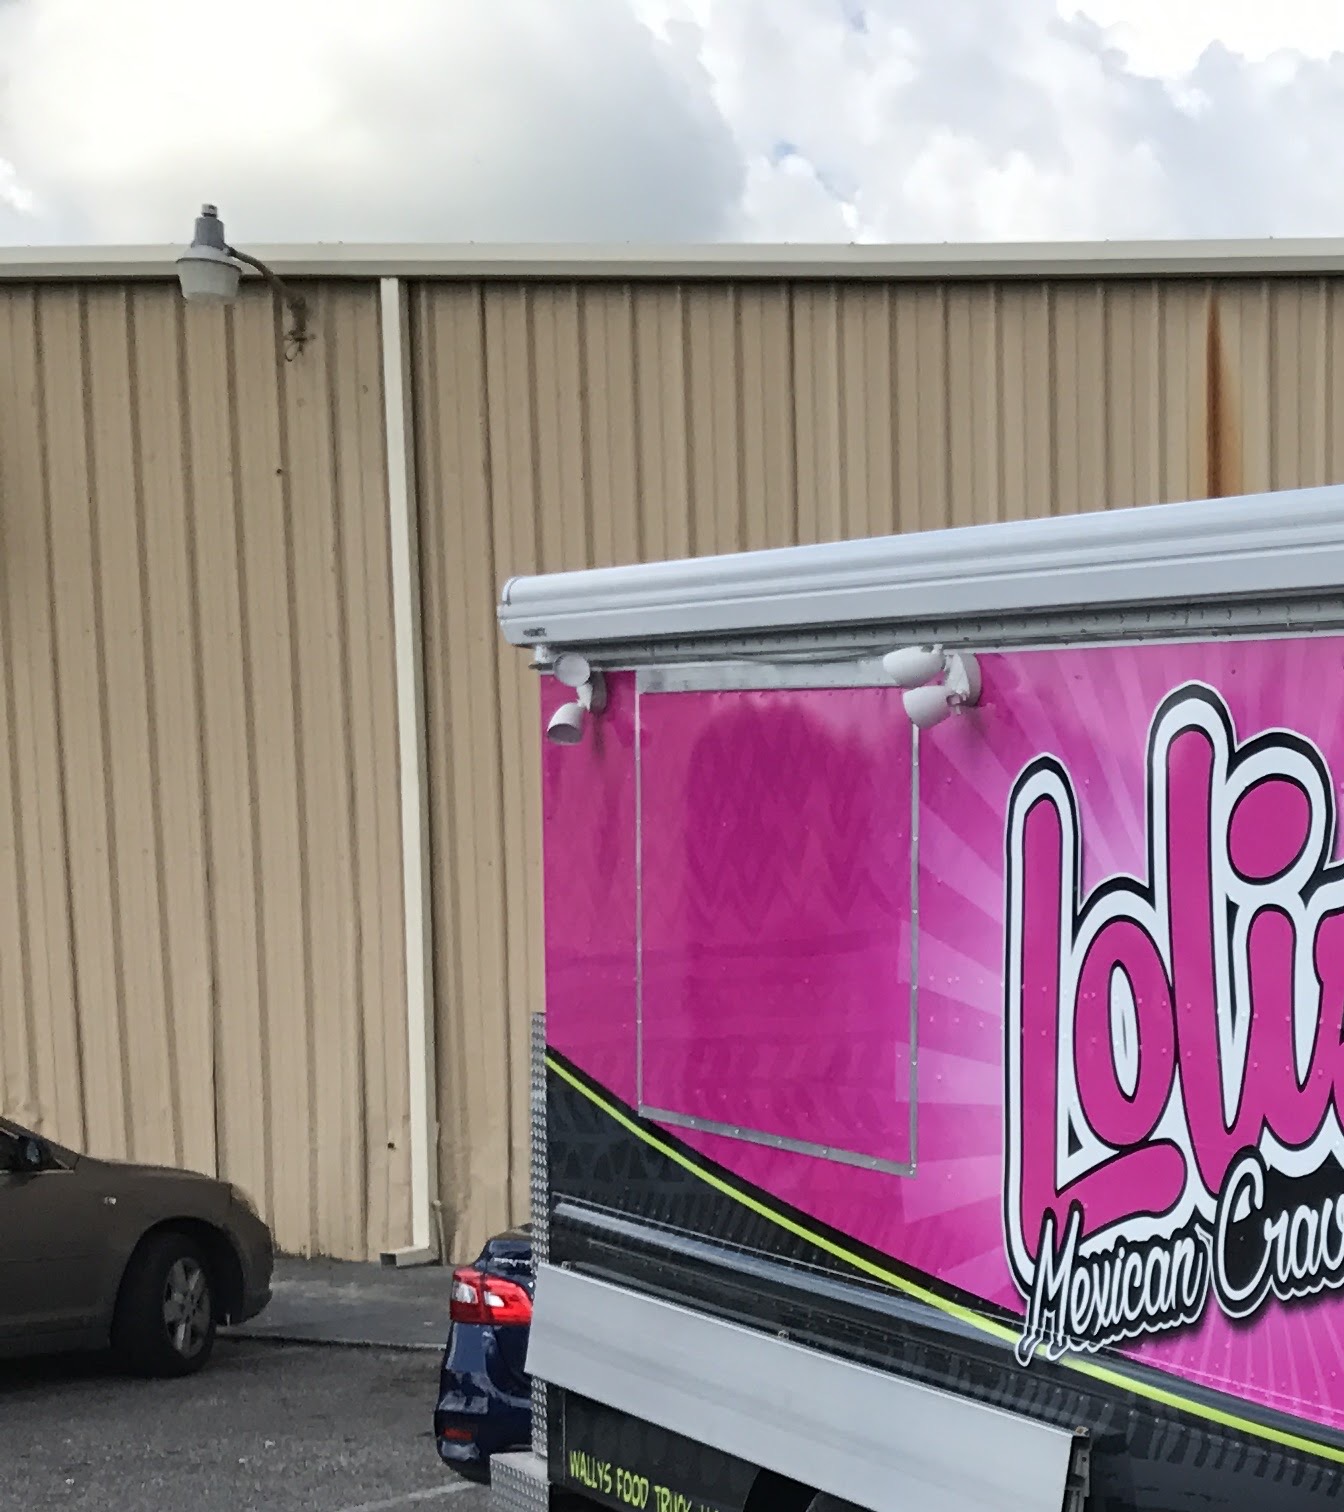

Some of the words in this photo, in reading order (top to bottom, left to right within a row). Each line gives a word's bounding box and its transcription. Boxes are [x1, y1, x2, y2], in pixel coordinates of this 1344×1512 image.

[1017, 1207, 1206, 1362] Mexican
[569, 1450, 613, 1494] WALLYS
[616, 1467, 650, 1510] FOOD
